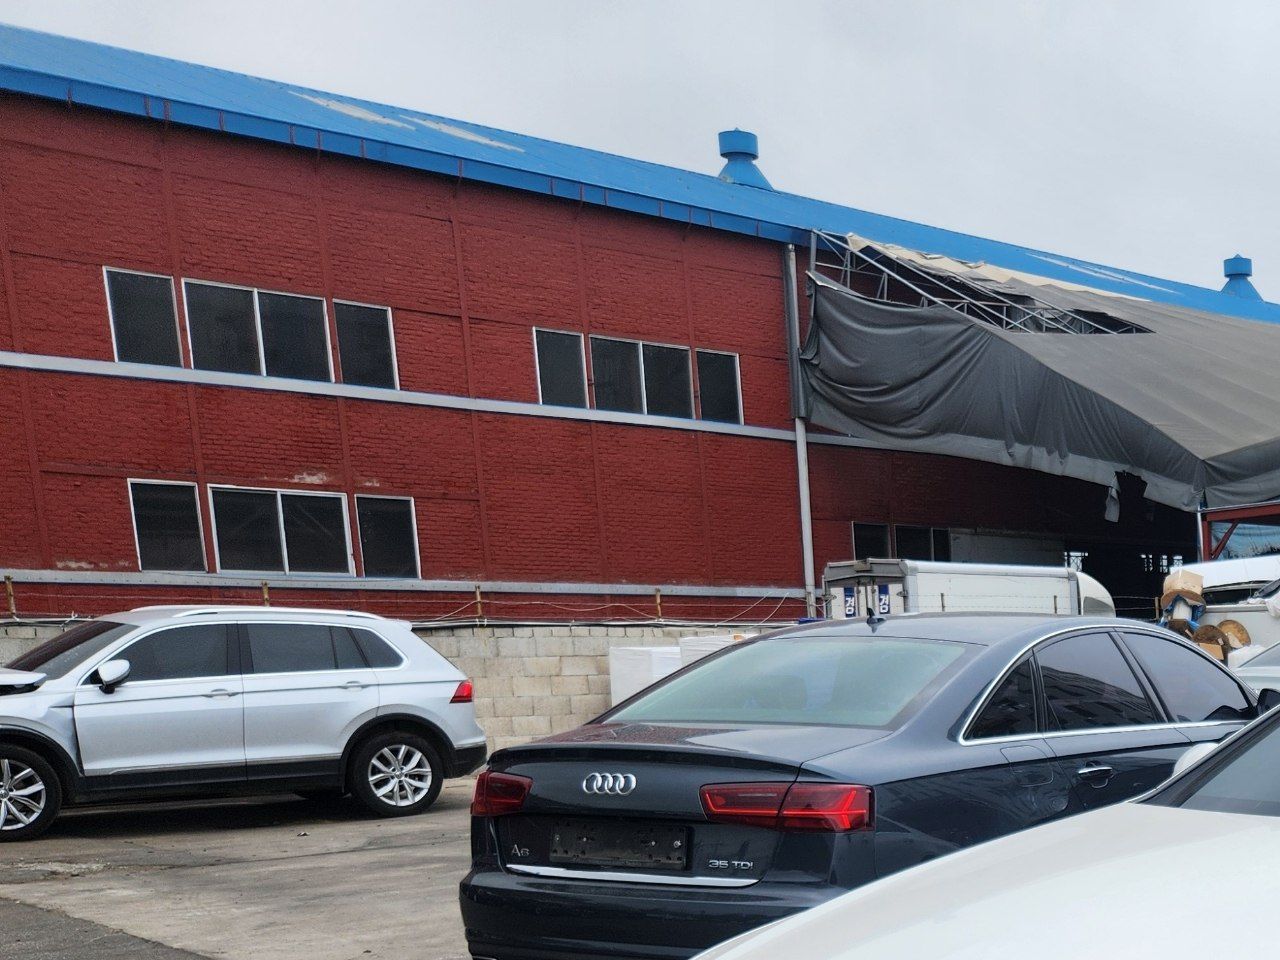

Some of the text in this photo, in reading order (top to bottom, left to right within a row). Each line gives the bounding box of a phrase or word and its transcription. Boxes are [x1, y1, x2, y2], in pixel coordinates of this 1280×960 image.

[845, 597, 855, 615] 경
[880, 594, 889, 613] 경
[511, 844, 530, 857] A6
[708, 859, 754, 870] 35 TDI
